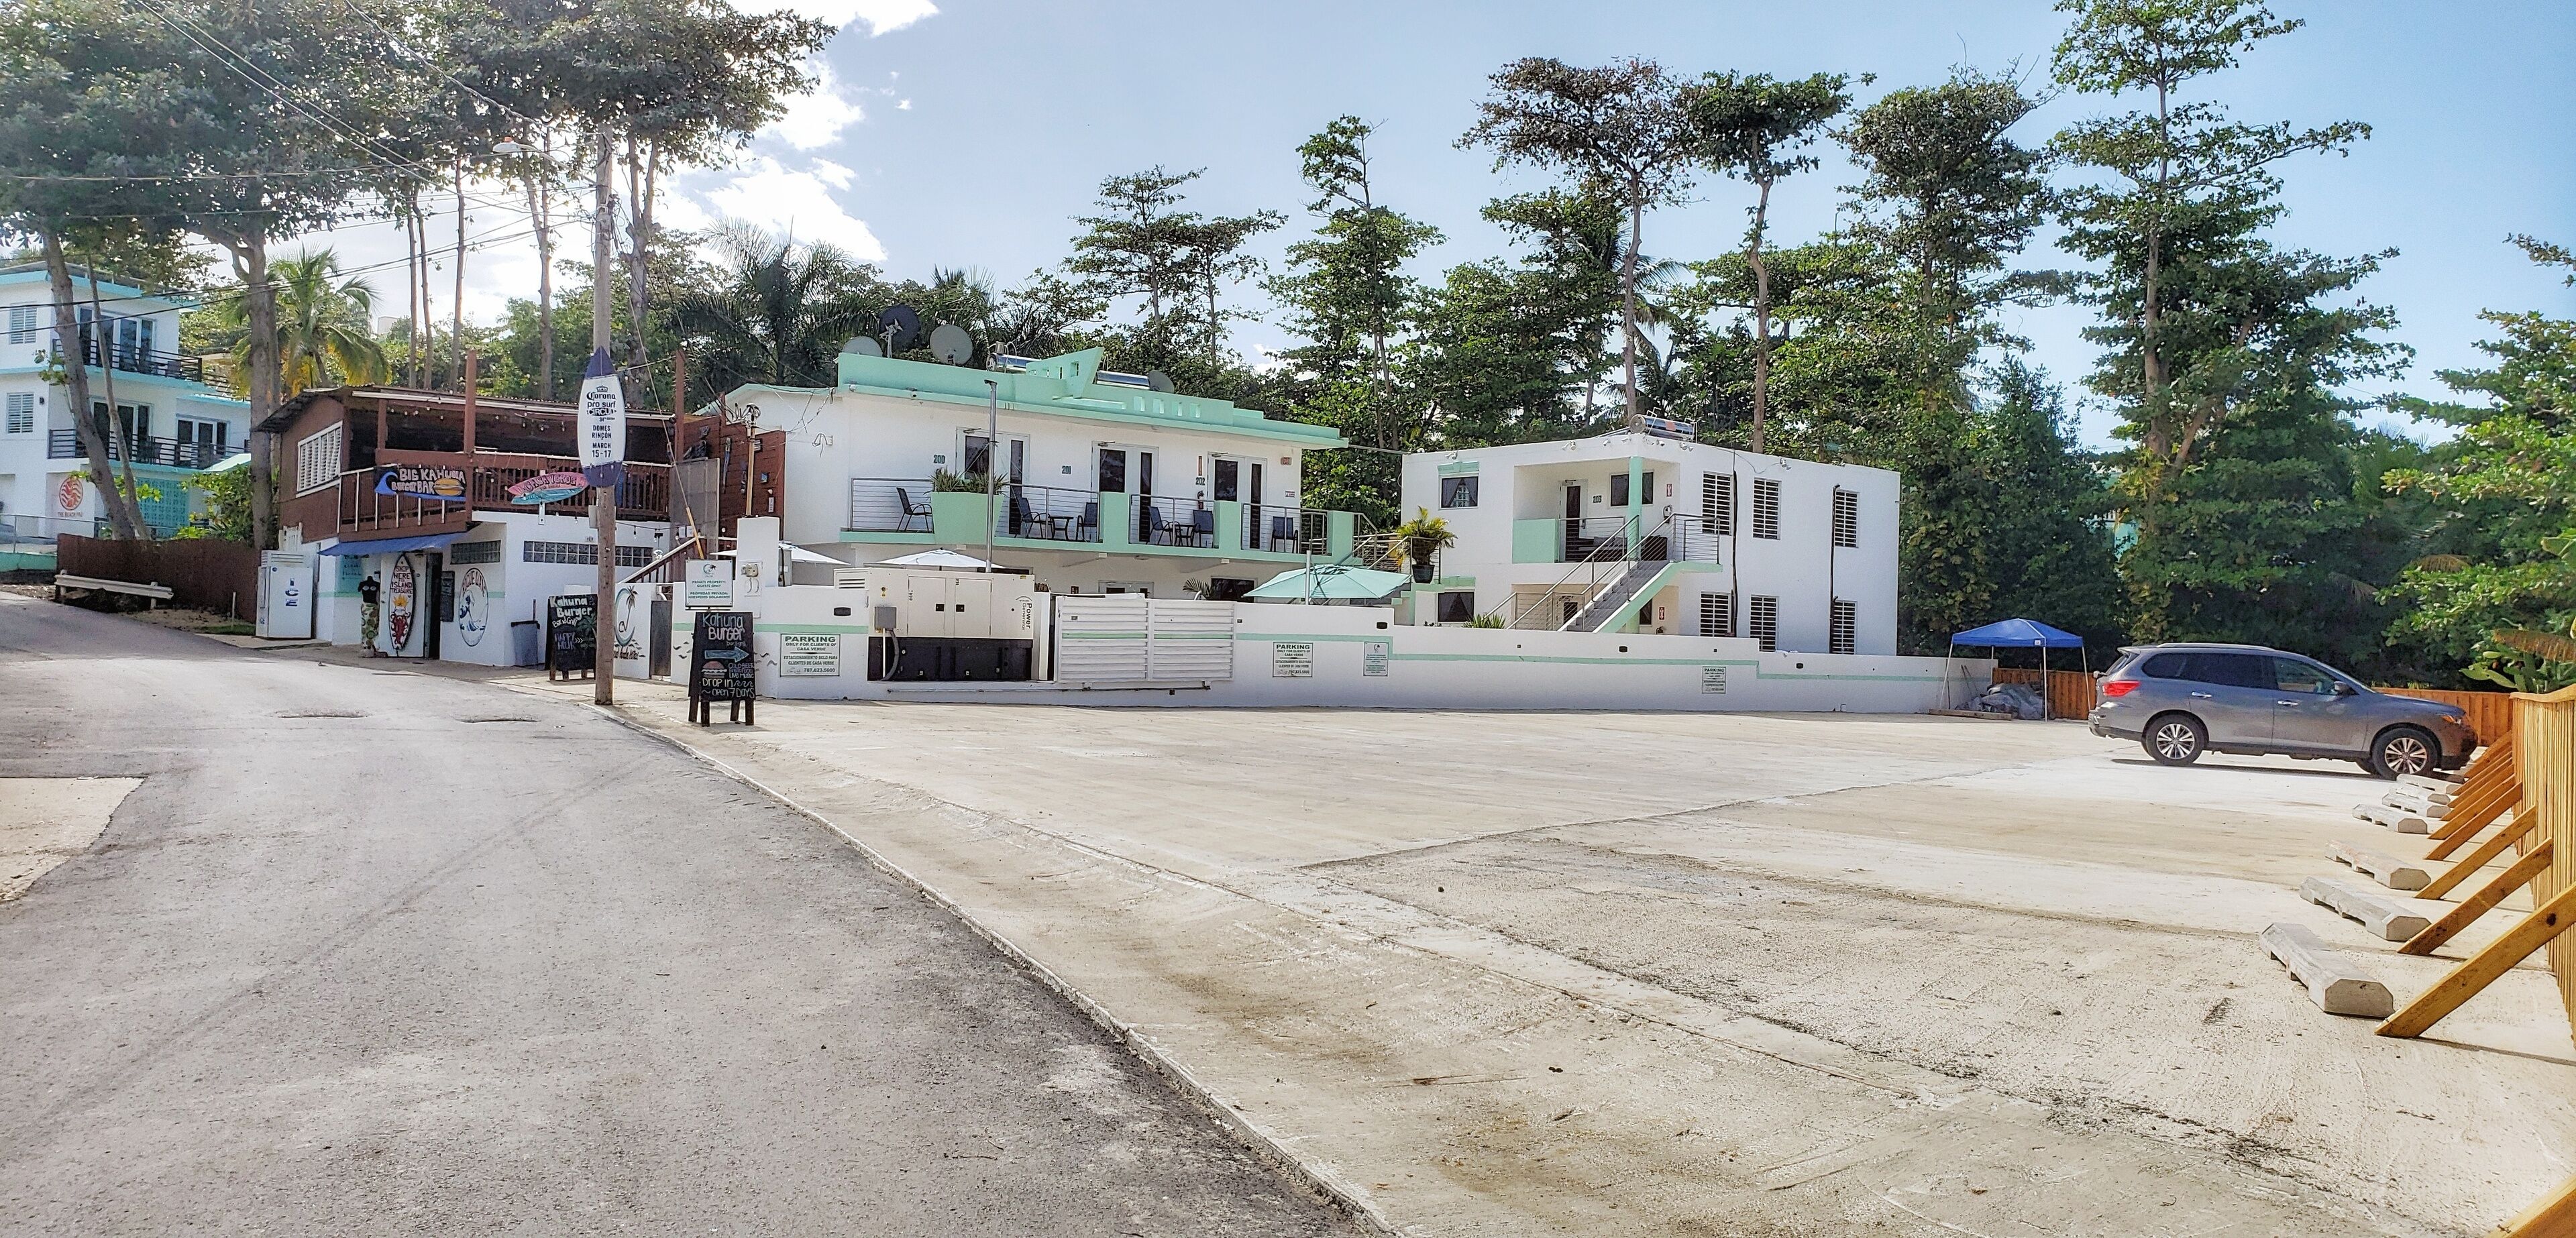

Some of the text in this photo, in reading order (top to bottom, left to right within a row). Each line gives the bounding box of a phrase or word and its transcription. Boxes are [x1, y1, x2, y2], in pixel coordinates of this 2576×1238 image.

[586, 391, 616, 401] Corona
[592, 449, 611, 457] 15-17
[933, 455, 945, 464] 200
[1061, 465, 1071, 475] 201
[525, 475, 549, 492] CASA
[549, 474, 577, 486] VERDE
[1195, 477, 1205, 486] 202
[417, 480, 435, 494] BAR
[1593, 495, 1602, 504] 203
[285, 577, 299, 607] ICE
[549, 596, 588, 608] Kahuna
[556, 607, 593, 620] Burger
[702, 612, 743, 628] Kahuna
[729, 687, 736, 696] 7
